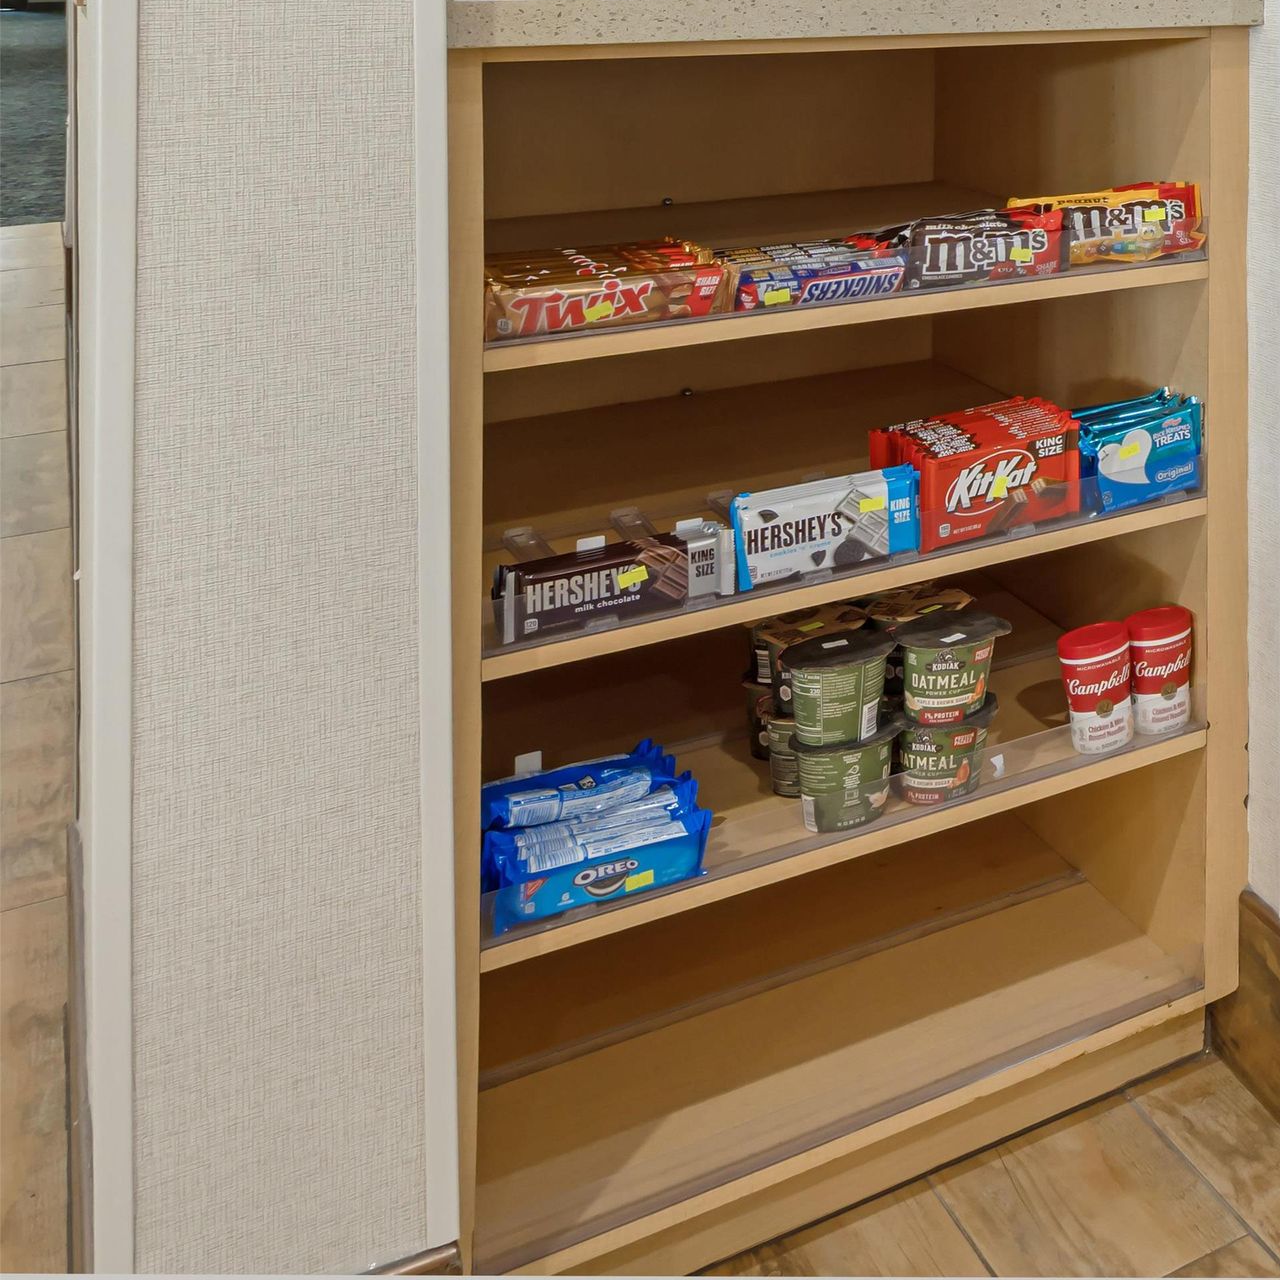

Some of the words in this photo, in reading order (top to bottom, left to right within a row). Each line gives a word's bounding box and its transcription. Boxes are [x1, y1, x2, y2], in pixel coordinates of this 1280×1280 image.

[1057, 196, 1109, 205] peanut
[696, 277, 720, 286] SHARE
[802, 273, 899, 303] SNICKERS
[510, 278, 654, 336] Twix
[1036, 435, 1063, 449] KING
[1154, 430, 1191, 448] TREATS
[1038, 445, 1063, 458] SIZE
[1158, 464, 1192, 480] Original
[890, 497, 910, 511] KING
[894, 510, 911, 523] SIZE
[747, 511, 842, 555] HERSHEY'S
[690, 548, 715, 564] KING
[695, 562, 715, 578] SIZE
[575, 603, 595, 614] milk
[597, 593, 641, 609] chocolate
[932, 662, 959, 671] KODIAK
[1135, 648, 1192, 678] Campbell
[912, 670, 976, 690] OATMEAL
[934, 711, 959, 719] PROTEIN
[912, 743, 937, 752] KODIAK
[574, 860, 638, 886] OREO
